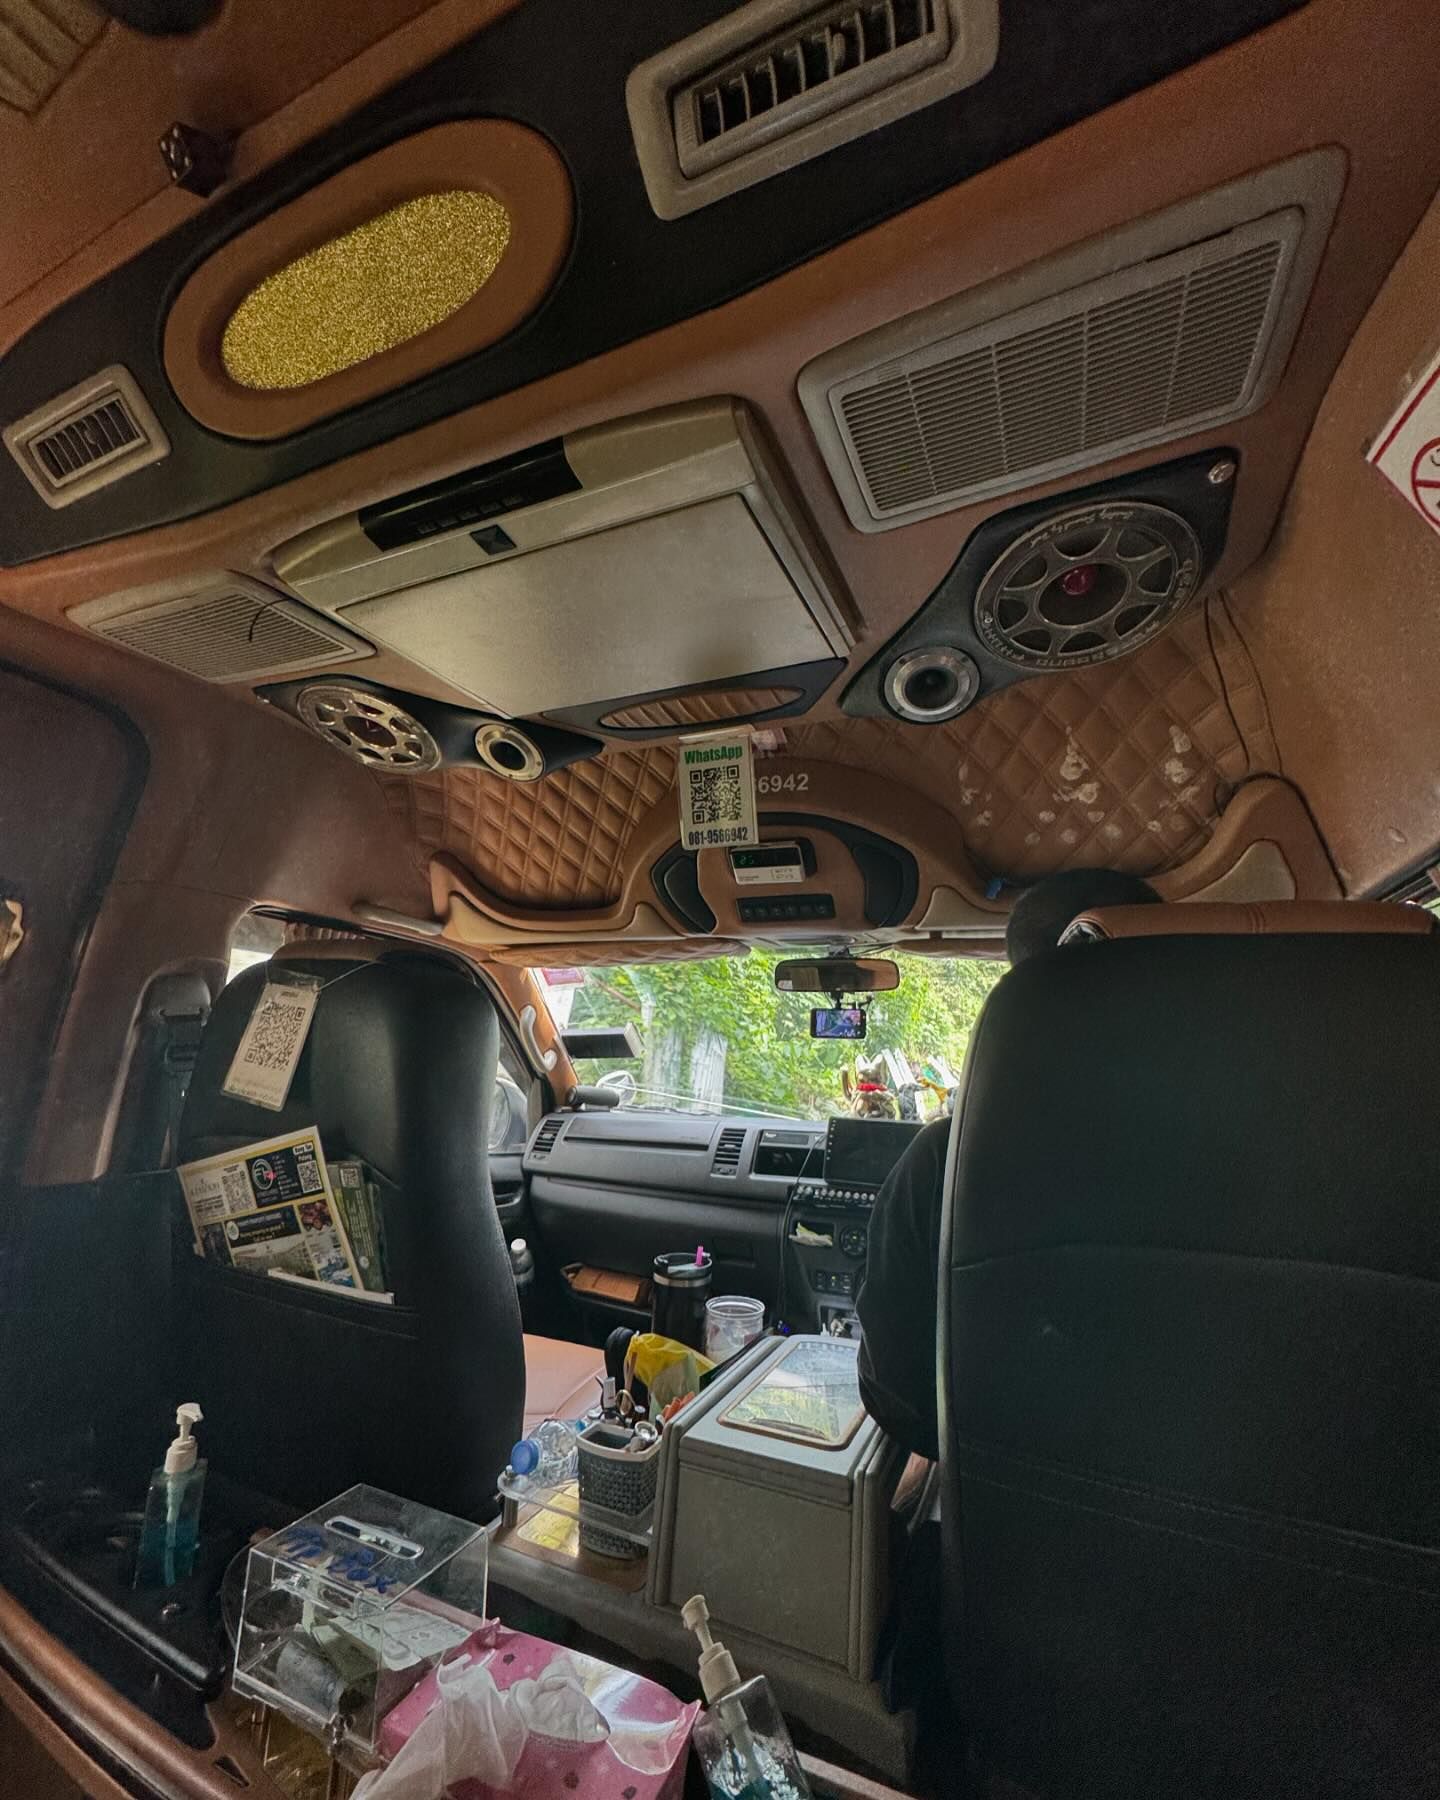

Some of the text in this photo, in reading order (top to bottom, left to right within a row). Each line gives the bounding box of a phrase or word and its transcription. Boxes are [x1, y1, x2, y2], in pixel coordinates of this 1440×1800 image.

[684, 745, 743, 765] WhatsApp
[756, 773, 809, 793] 6942
[688, 826, 748, 845] 081-9566942
